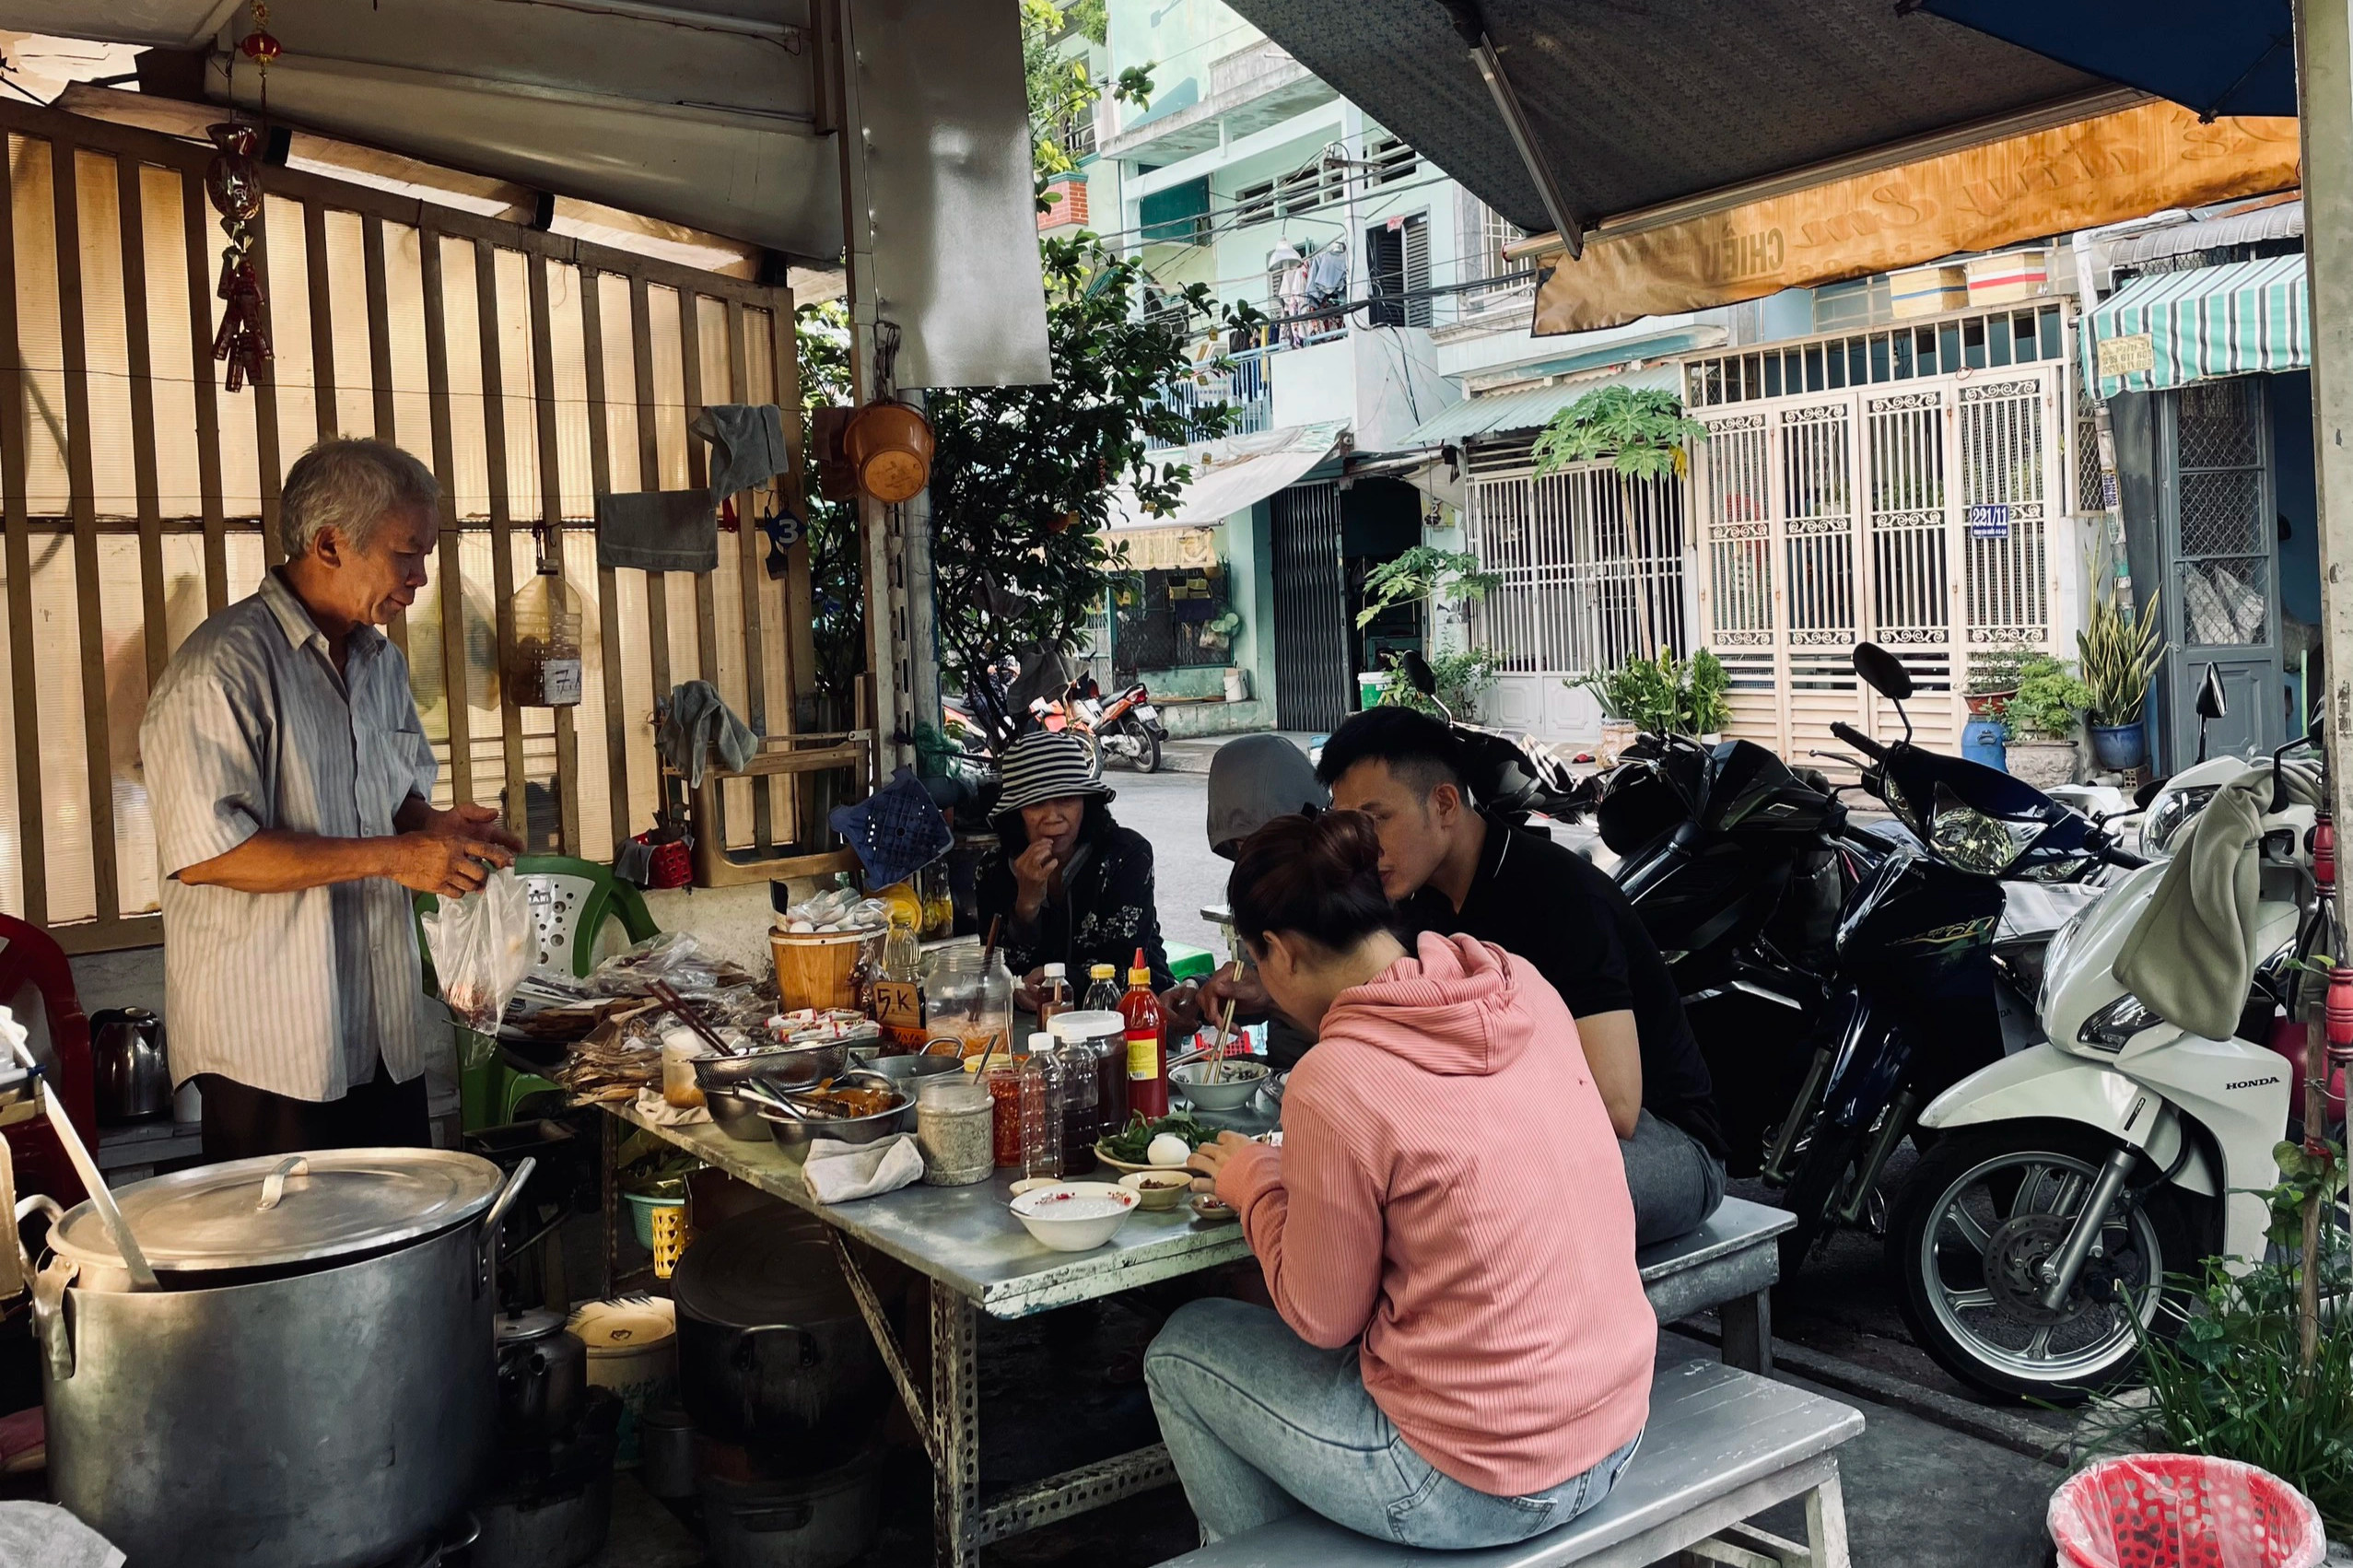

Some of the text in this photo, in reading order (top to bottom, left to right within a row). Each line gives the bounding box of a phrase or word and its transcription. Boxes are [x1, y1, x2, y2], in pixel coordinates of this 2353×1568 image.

[1973, 507, 2008, 526] 221/11
[778, 518, 799, 544] 3
[2226, 1076, 2280, 1090] HONDA
